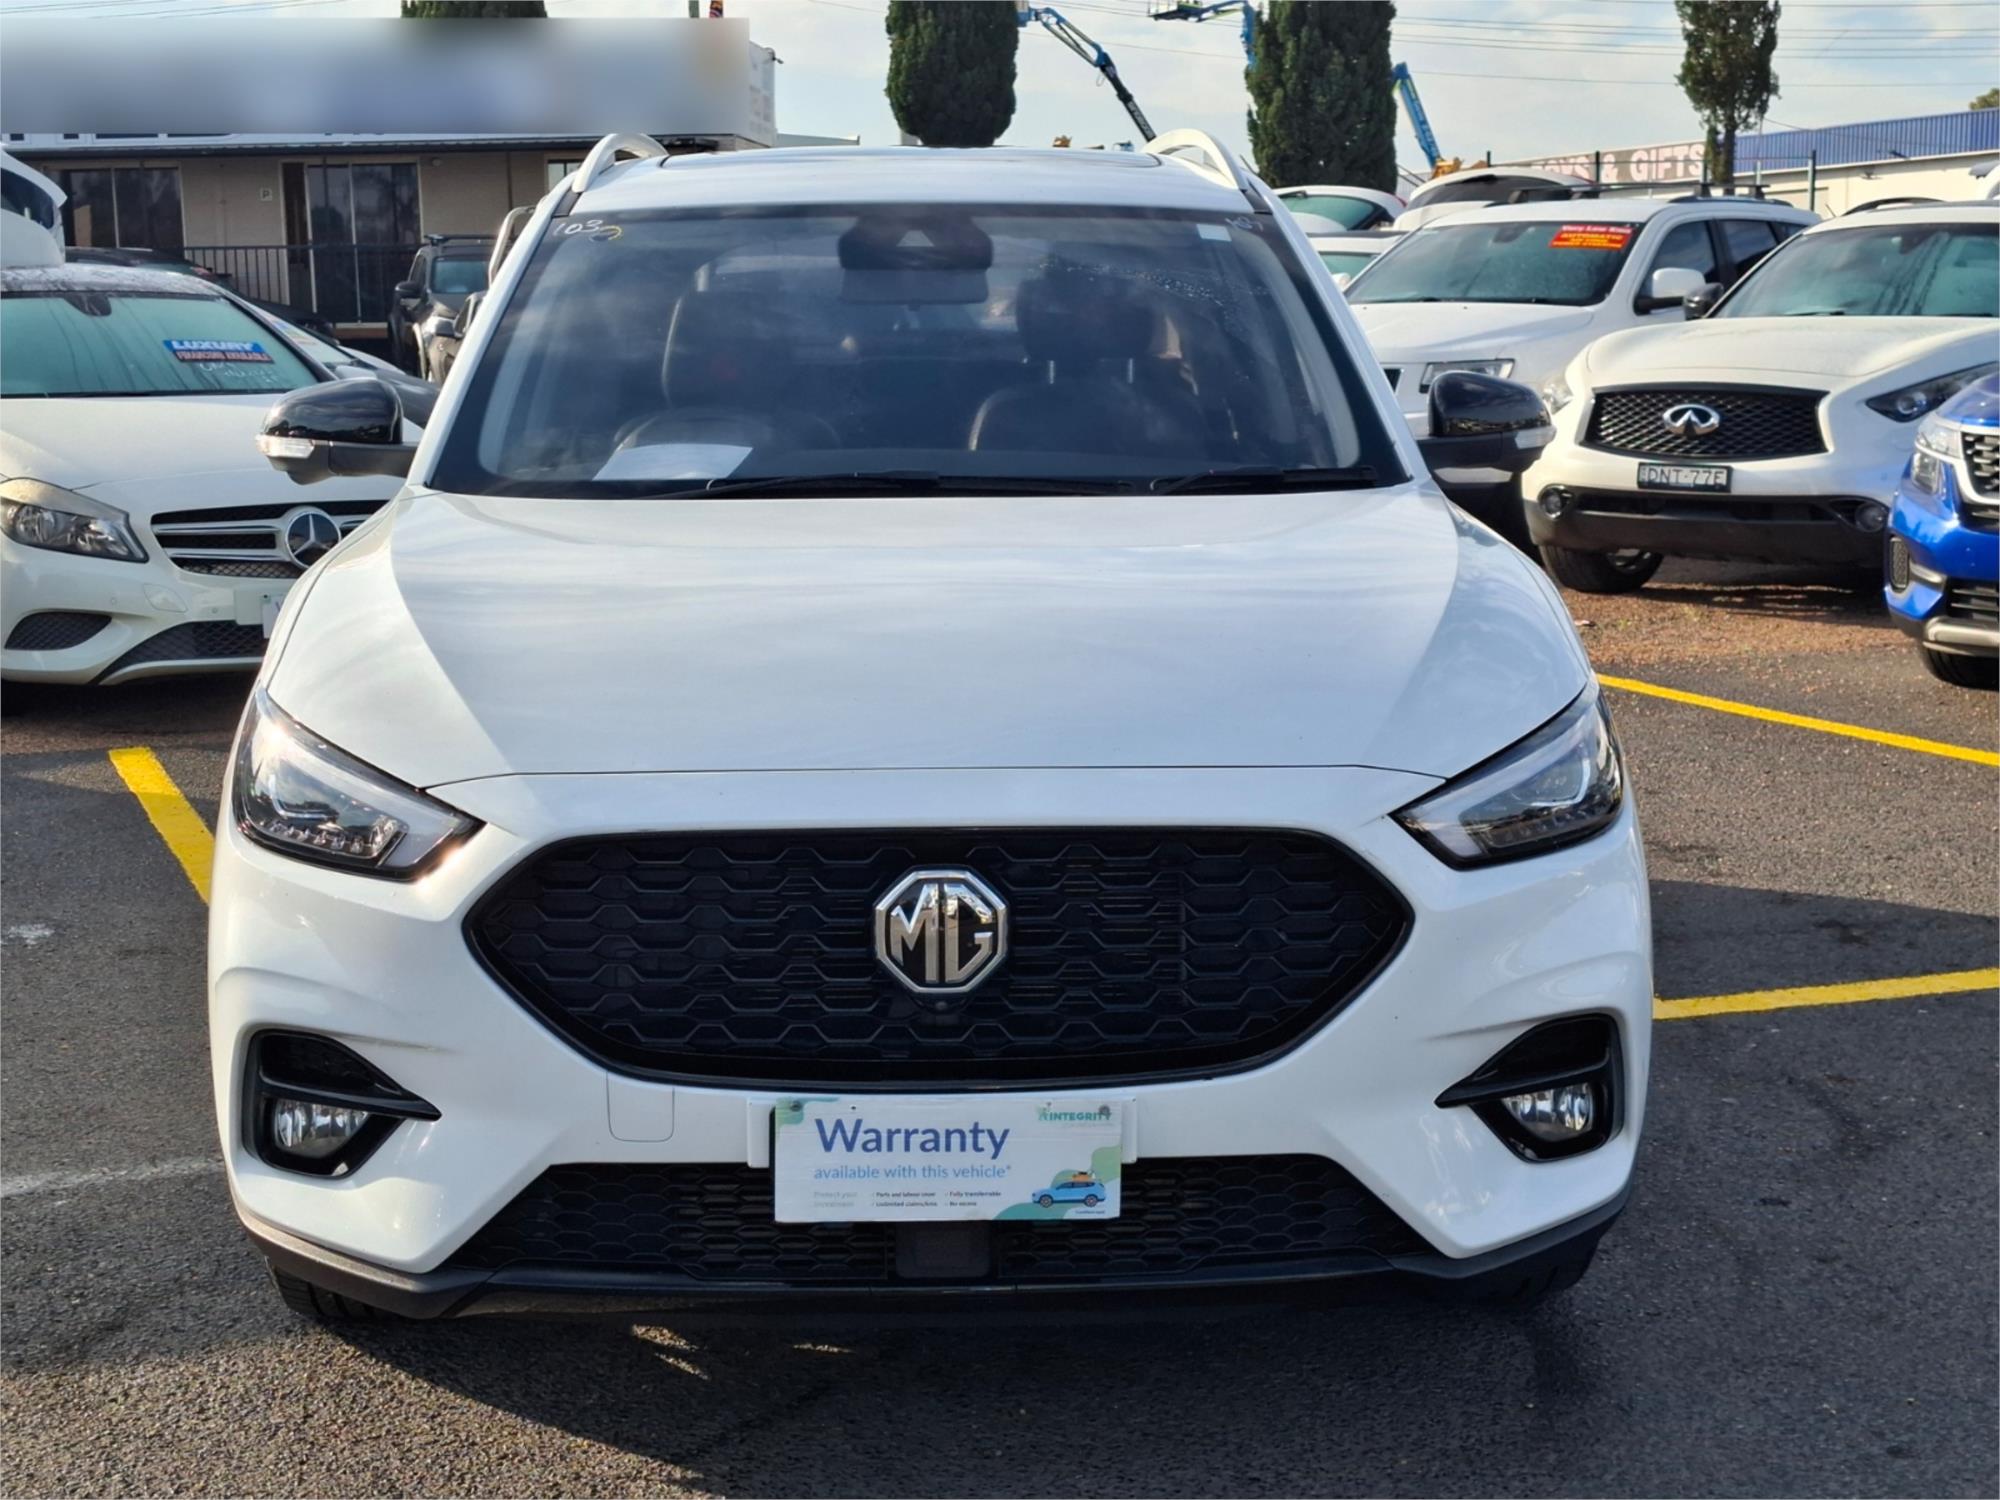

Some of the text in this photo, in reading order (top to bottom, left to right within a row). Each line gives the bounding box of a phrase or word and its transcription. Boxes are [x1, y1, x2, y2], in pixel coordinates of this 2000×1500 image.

[1601, 153, 1619, 183] &
[1629, 144, 1705, 182] GIFTS
[171, 340, 253, 352] LUXURY
[890, 883, 994, 984] MG
[814, 1117, 1010, 1160] Warranty
[814, 1164, 880, 1179] available
[882, 1164, 917, 1179] with
[922, 1164, 949, 1179] this
